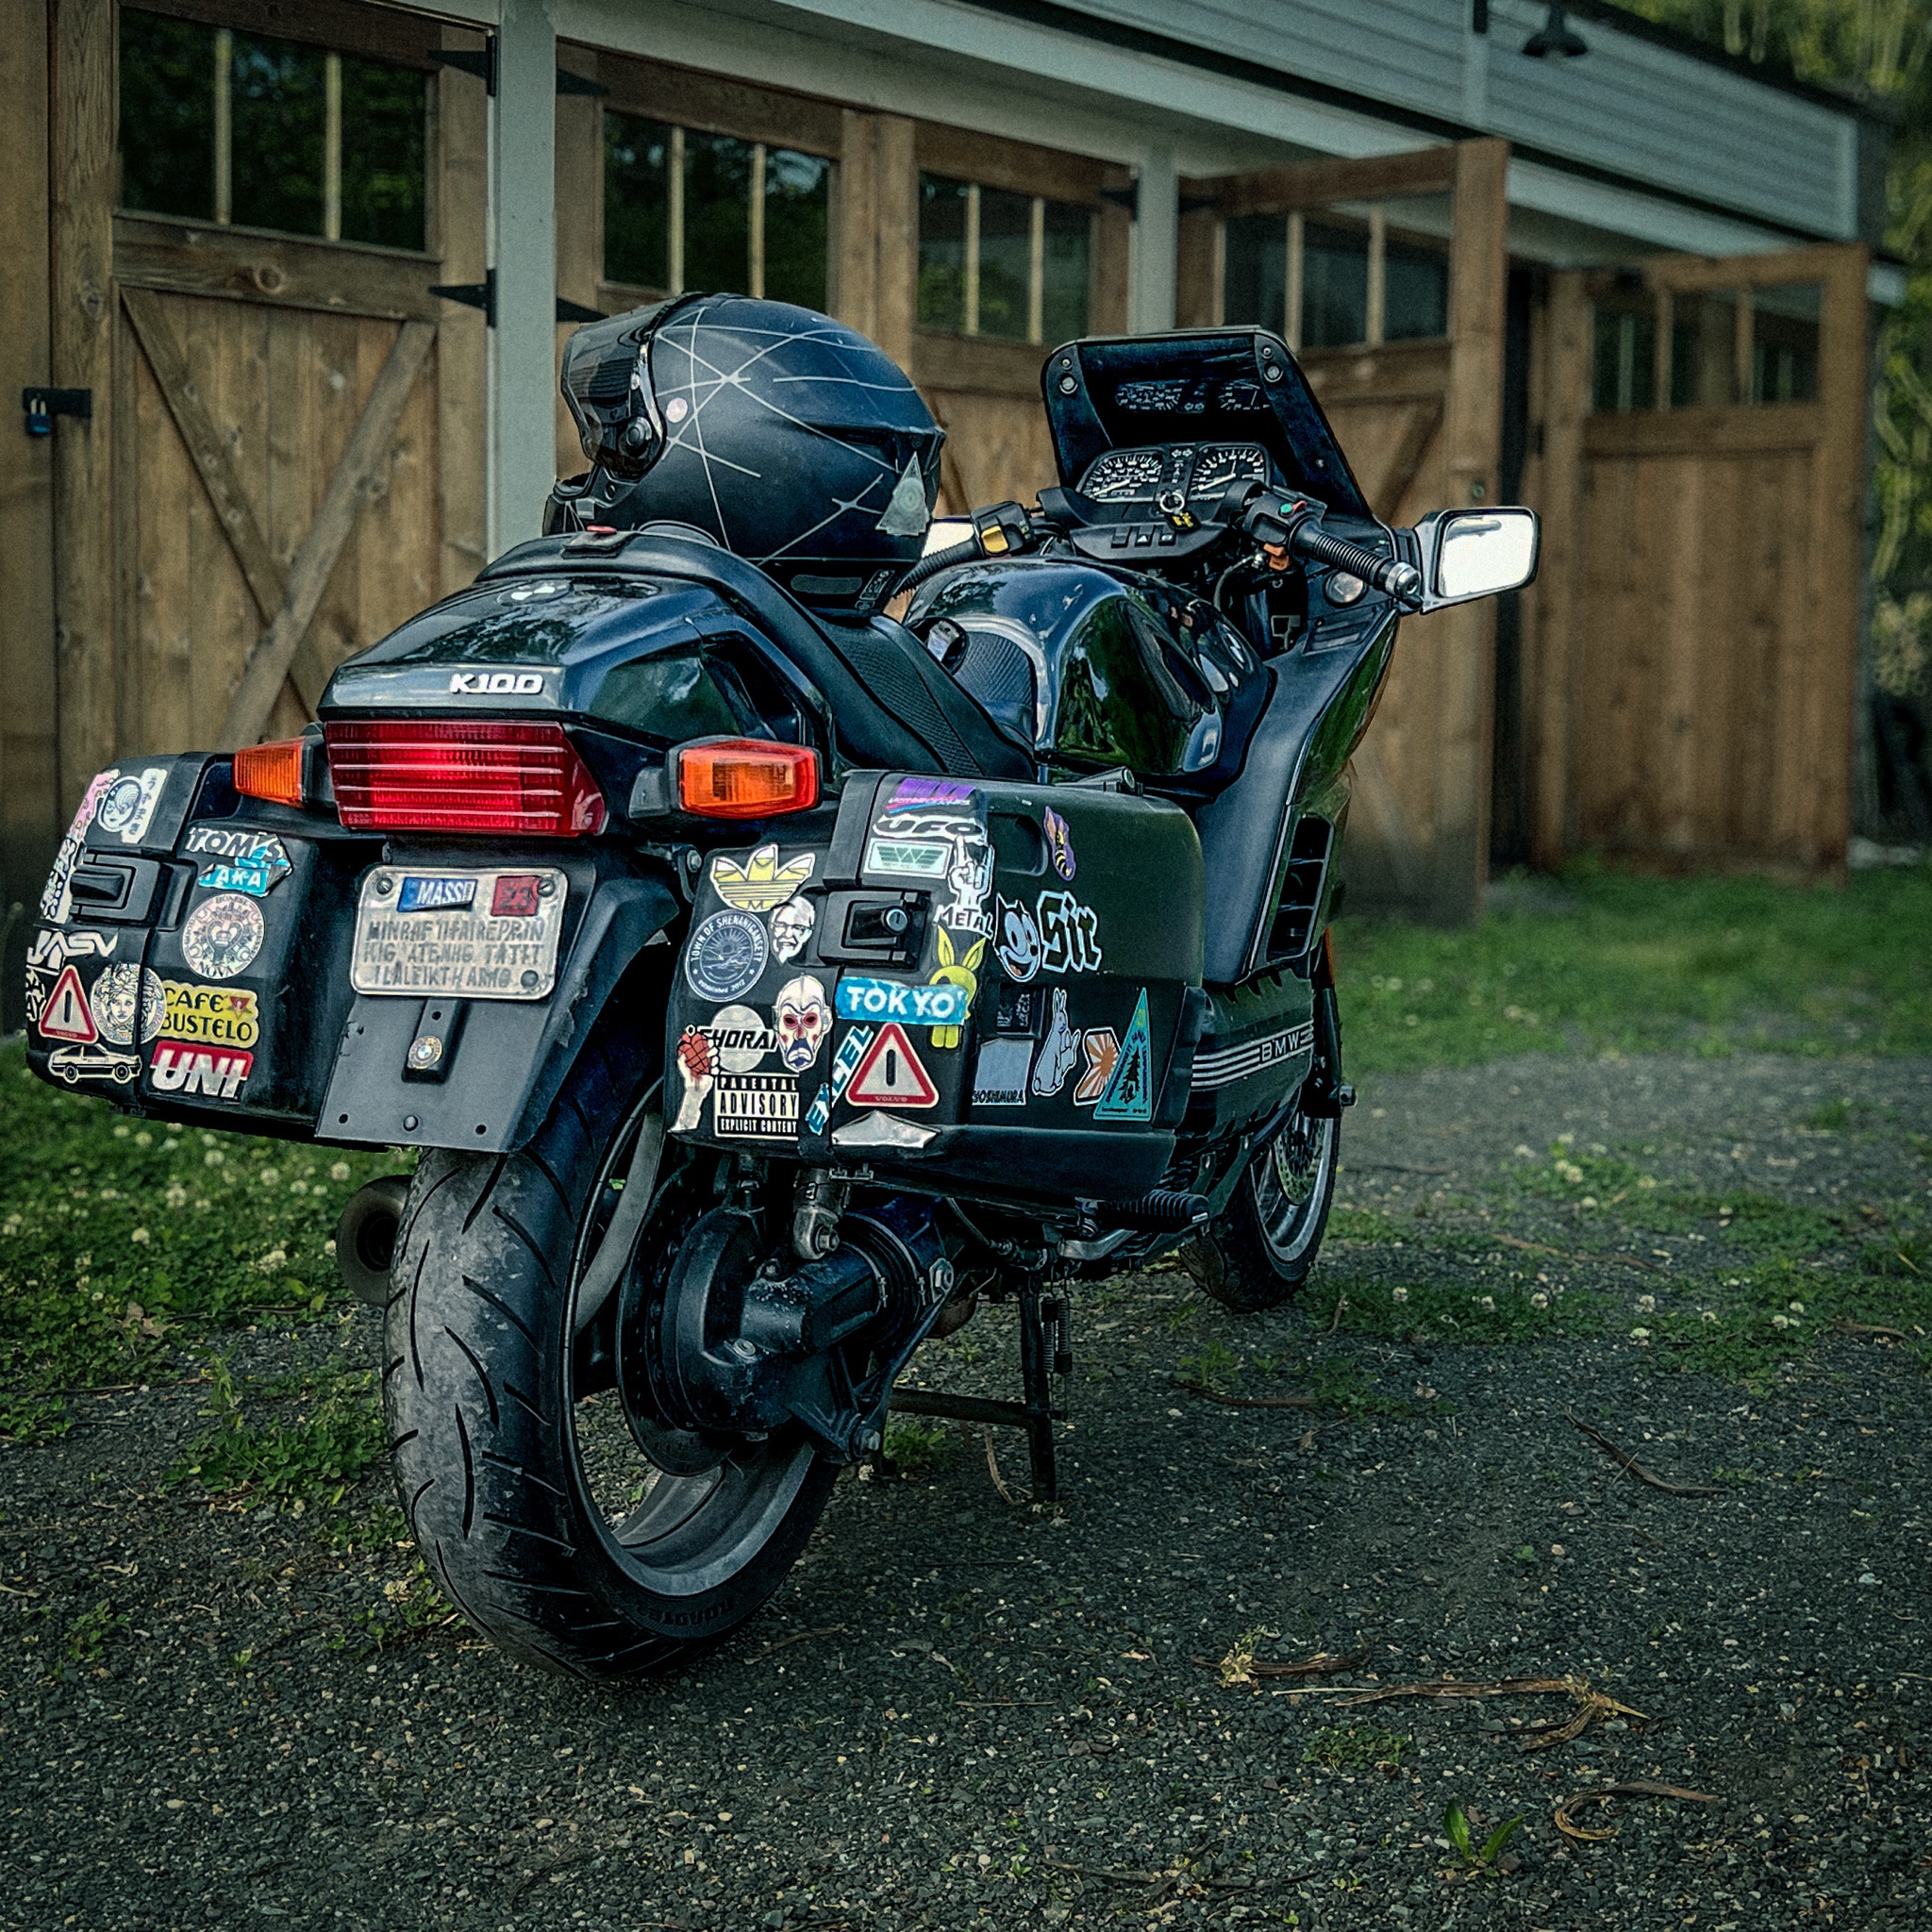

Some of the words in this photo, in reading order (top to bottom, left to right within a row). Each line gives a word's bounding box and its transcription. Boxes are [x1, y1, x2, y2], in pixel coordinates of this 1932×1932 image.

[450, 674, 544, 694] K100
[874, 819, 983, 836] UFO
[500, 886, 532, 909] 23
[934, 906, 993, 935] METAL
[691, 935, 706, 962] TOWN
[704, 923, 715, 936] OF
[847, 985, 956, 1018] TOKYO
[161, 1011, 252, 1041] BUSTELO
[1261, 1031, 1300, 1061] BMW
[151, 1049, 247, 1097] UNI
[721, 1077, 796, 1091] PARENTAL
[720, 1092, 797, 1117] ADVISORY
[721, 1118, 757, 1132] EXPLICIT
[760, 1120, 797, 1133] CONTENT
